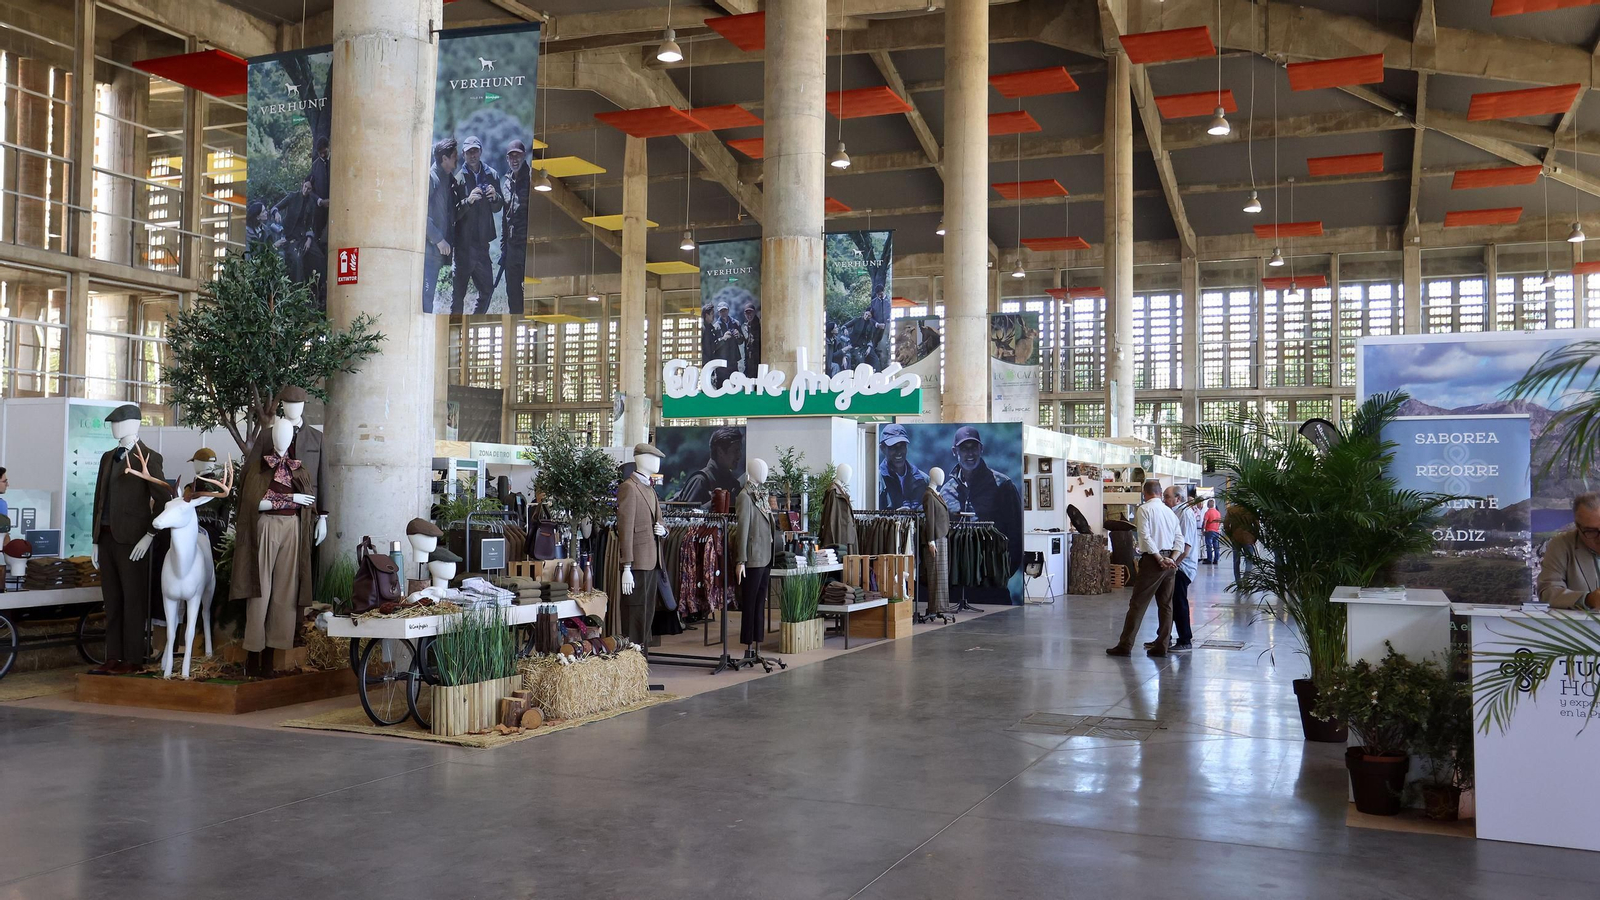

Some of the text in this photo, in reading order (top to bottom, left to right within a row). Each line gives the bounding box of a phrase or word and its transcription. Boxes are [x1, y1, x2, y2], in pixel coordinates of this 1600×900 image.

[450, 75, 526, 90] VERHUNT
[261, 97, 328, 115] VERHUNT
[834, 259, 884, 268] VERHUNT
[707, 266, 753, 277] VERHUNT
[663, 346, 922, 412] El Corte Inglés
[1414, 432, 1500, 445] SABOREA
[1415, 464, 1499, 477] RECORRE
[1432, 526, 1486, 542] CÁDIZ
[1559, 699, 1567, 707] y
[1559, 709, 1573, 717] en
[1576, 709, 1586, 718] la
